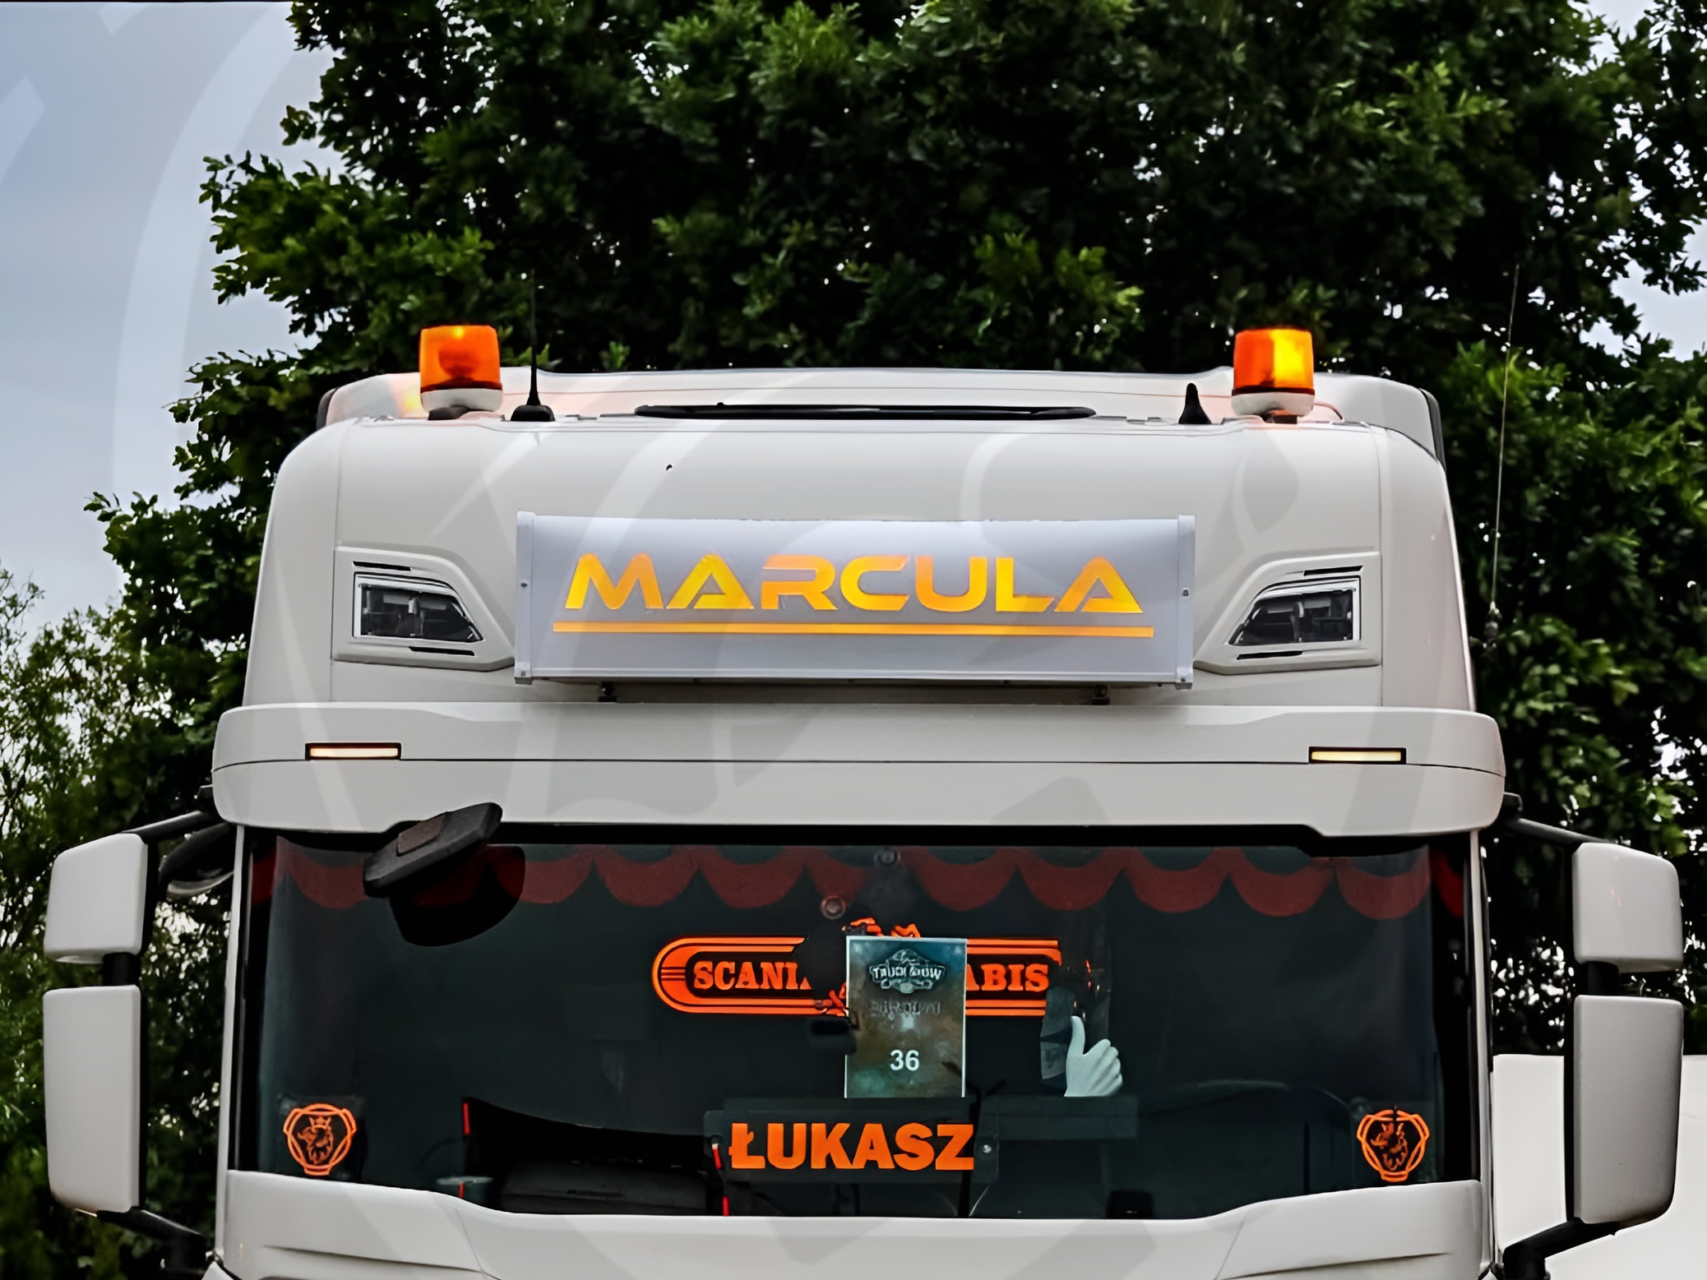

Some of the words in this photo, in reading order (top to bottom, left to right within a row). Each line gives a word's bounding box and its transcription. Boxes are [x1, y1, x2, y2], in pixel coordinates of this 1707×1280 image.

[565, 553, 1143, 614] MARCULA
[693, 960, 812, 990] SCANI
[966, 963, 1049, 992] ABIS
[890, 1049, 920, 1071] 36
[728, 1122, 975, 1171] ŁUKASZ
